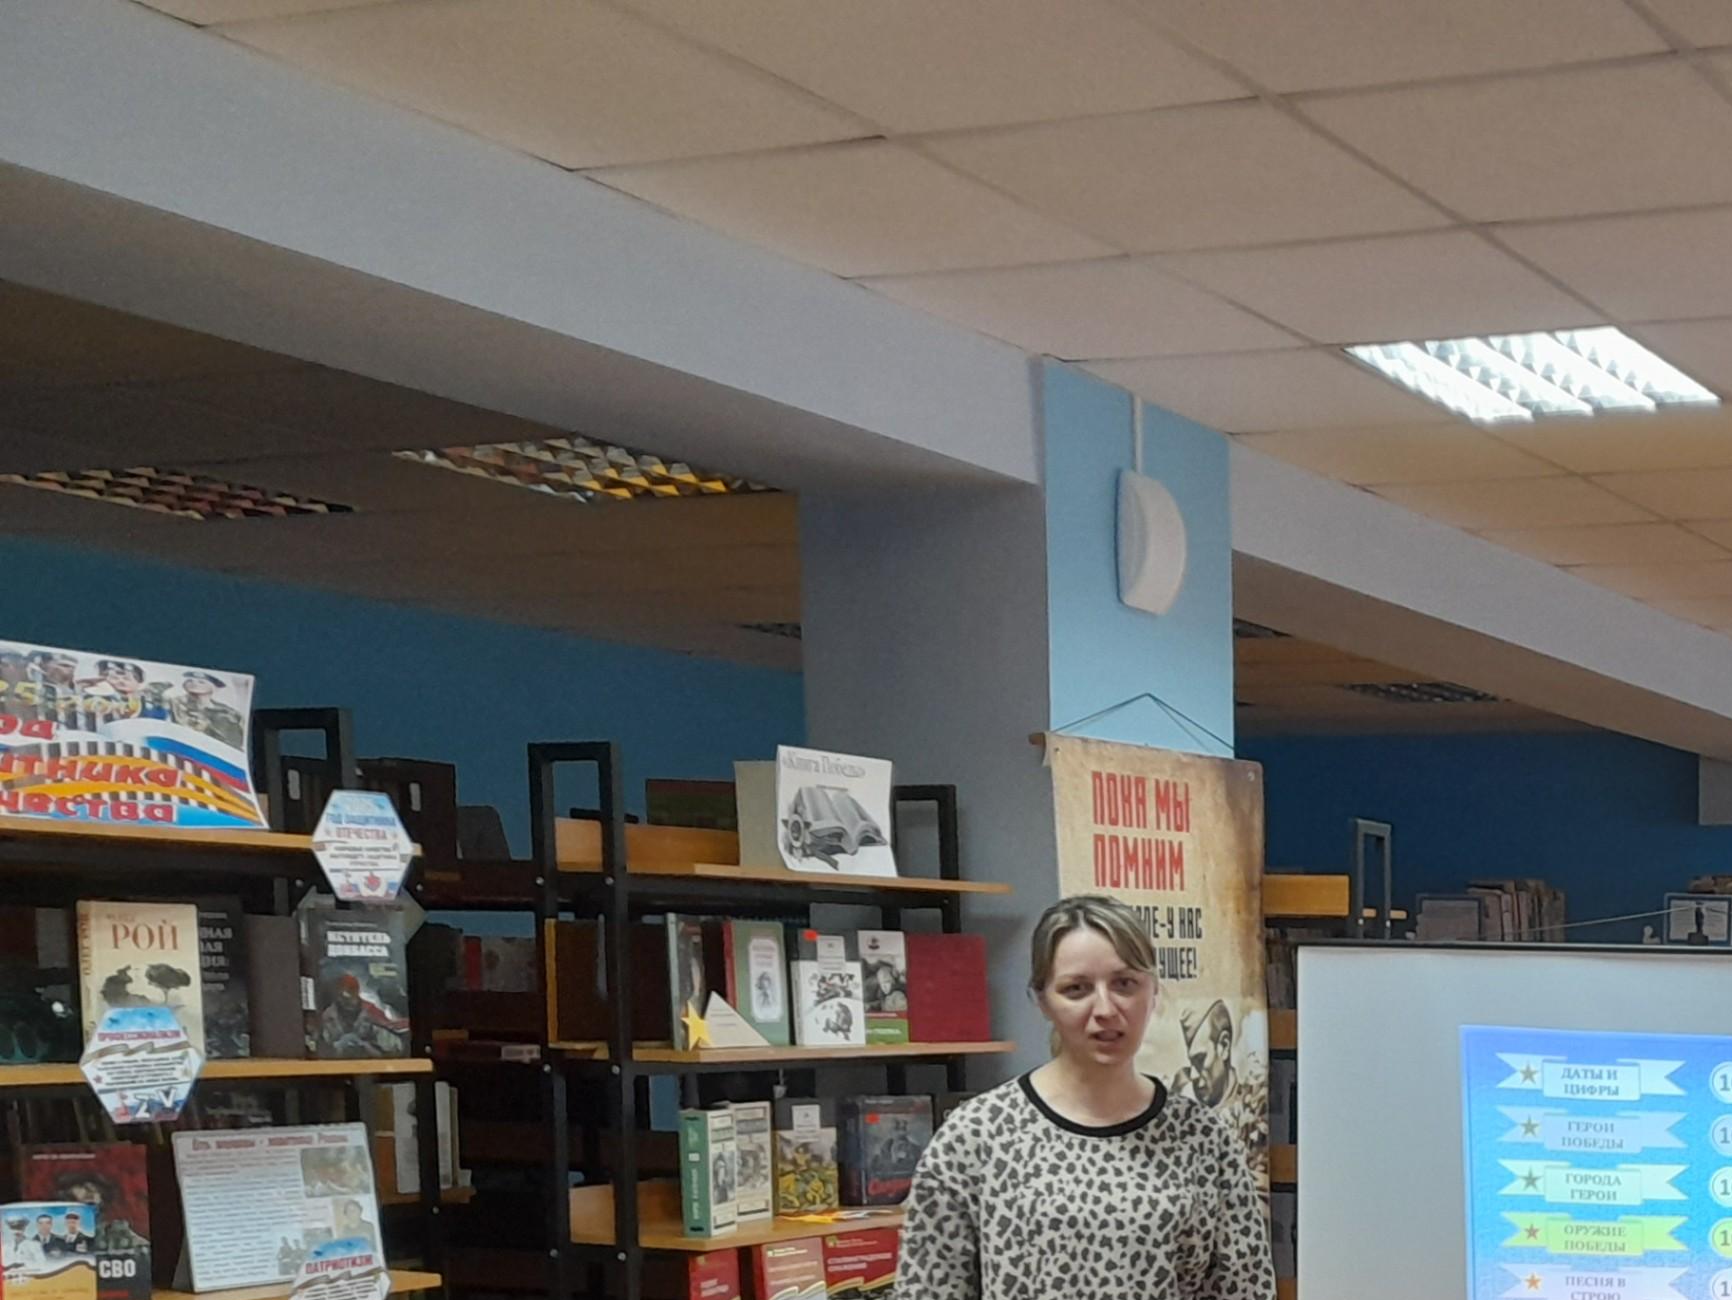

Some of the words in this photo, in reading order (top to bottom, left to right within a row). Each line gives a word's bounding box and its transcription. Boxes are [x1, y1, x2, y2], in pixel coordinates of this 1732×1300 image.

[1091, 771, 1147, 829] ПОКА
[1155, 777, 1190, 833] МЫ
[1093, 833, 1184, 891] ПОМНИМ
[111, 919, 178, 950] РОЙ
[1561, 1068, 1602, 1080] ДАТЫ
[1607, 1070, 1618, 1080] И
[1564, 1084, 1619, 1096] ЦИФРЫ
[1568, 1121, 1614, 1133] ГЕРОИ
[1561, 1137, 1624, 1149] ПОБЕДЫ
[1565, 1173, 1621, 1186] ГОРОДА
[1570, 1189, 1616, 1201] ГЕРОИ
[1564, 1225, 1626, 1237] ОРУЖИЕ
[1564, 1240, 1626, 1252] ПОБЕДЫ
[99, 1259, 136, 1278] СВО
[305, 1254, 373, 1274] ПАТРИОТИЗМ
[1565, 1276, 1614, 1287] ПЕСНЯ
[1617, 1277, 1626, 1287] В
